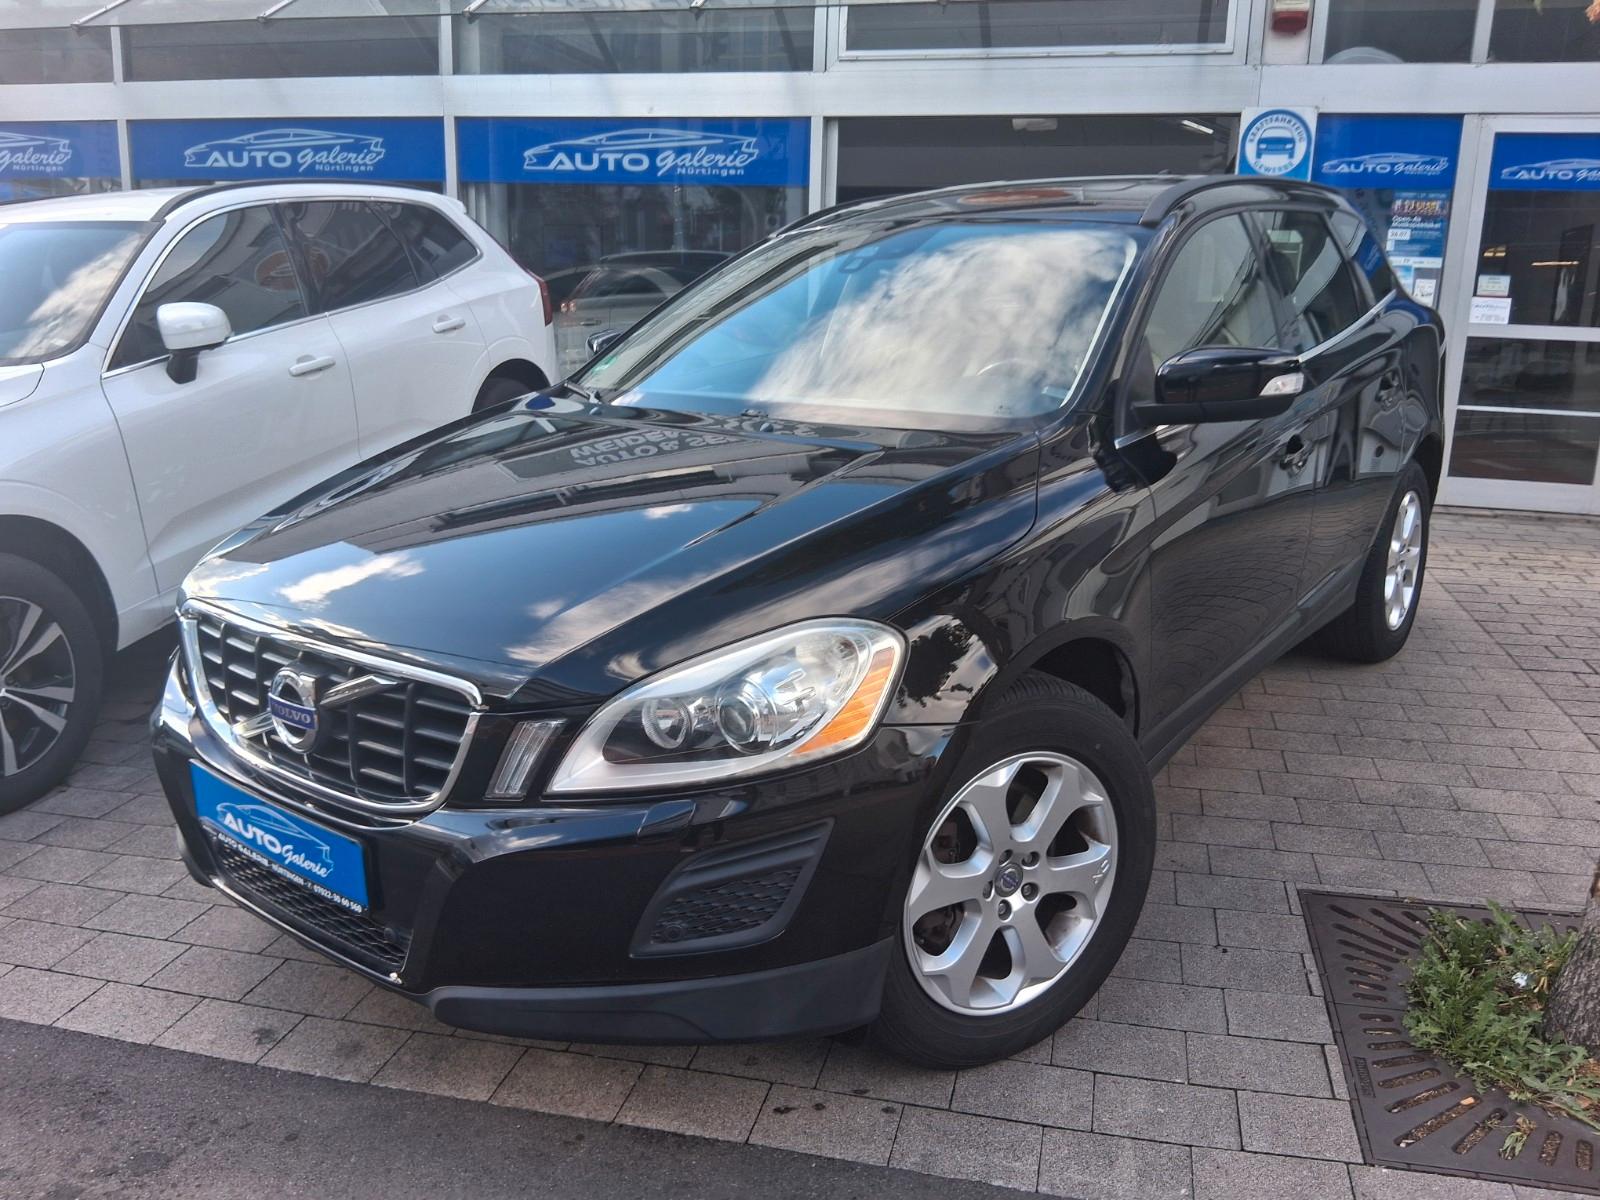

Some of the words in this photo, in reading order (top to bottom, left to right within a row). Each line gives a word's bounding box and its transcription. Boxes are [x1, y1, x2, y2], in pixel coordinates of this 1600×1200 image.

[206, 151, 293, 168] AUTO
[296, 145, 378, 172] galerie
[550, 152, 650, 172] AUTO
[655, 146, 749, 177] galerie
[13, 164, 64, 172] Nürtingen
[315, 164, 373, 172] Nürtingen
[677, 167, 745, 176] Nürtingen
[1336, 163, 1391, 174] AUTO
[1515, 169, 1574, 180] AUTO
[224, 812, 282, 855] AUTO
